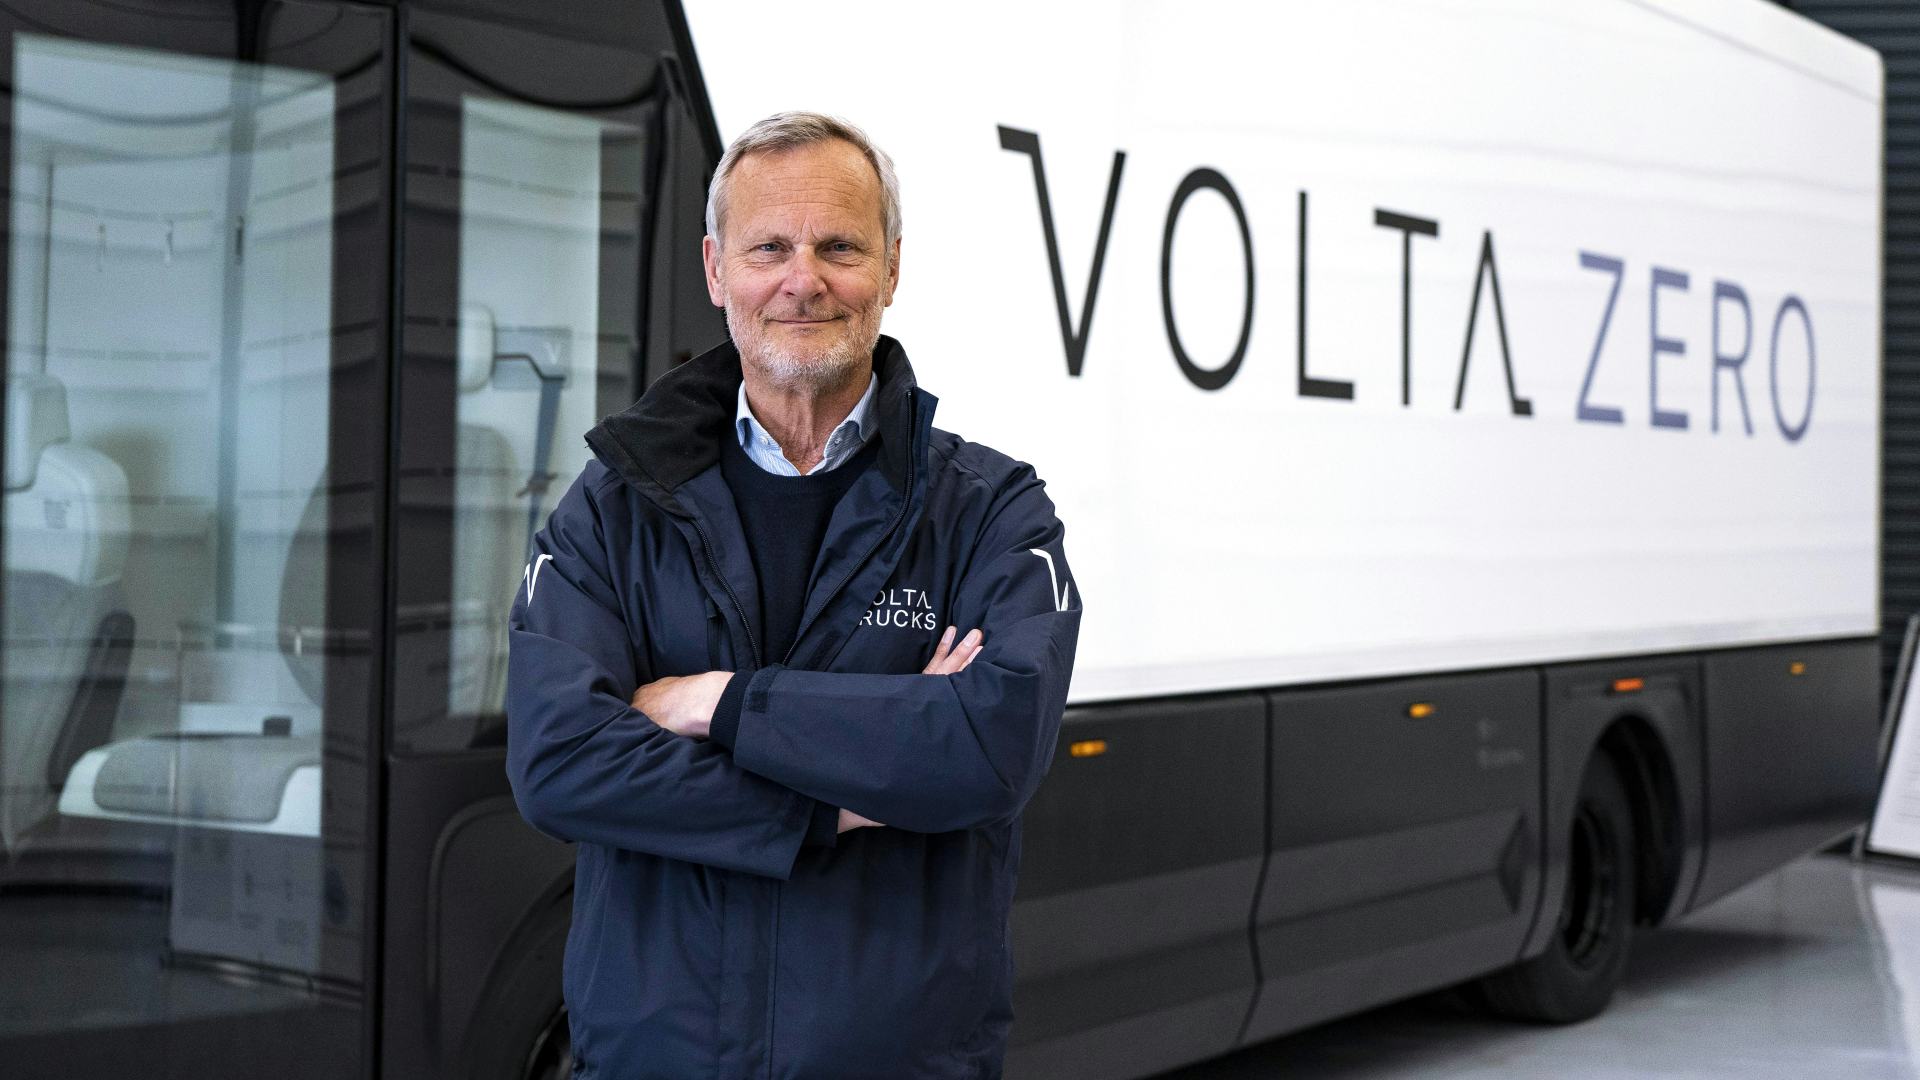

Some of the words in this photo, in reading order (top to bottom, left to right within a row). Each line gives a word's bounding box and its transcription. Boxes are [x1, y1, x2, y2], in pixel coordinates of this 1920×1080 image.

[996, 124, 1534, 417] VOLTA
[1576, 250, 1816, 444] ZERO
[872, 588, 932, 609] OLTA
[858, 608, 937, 631] RUCKS
